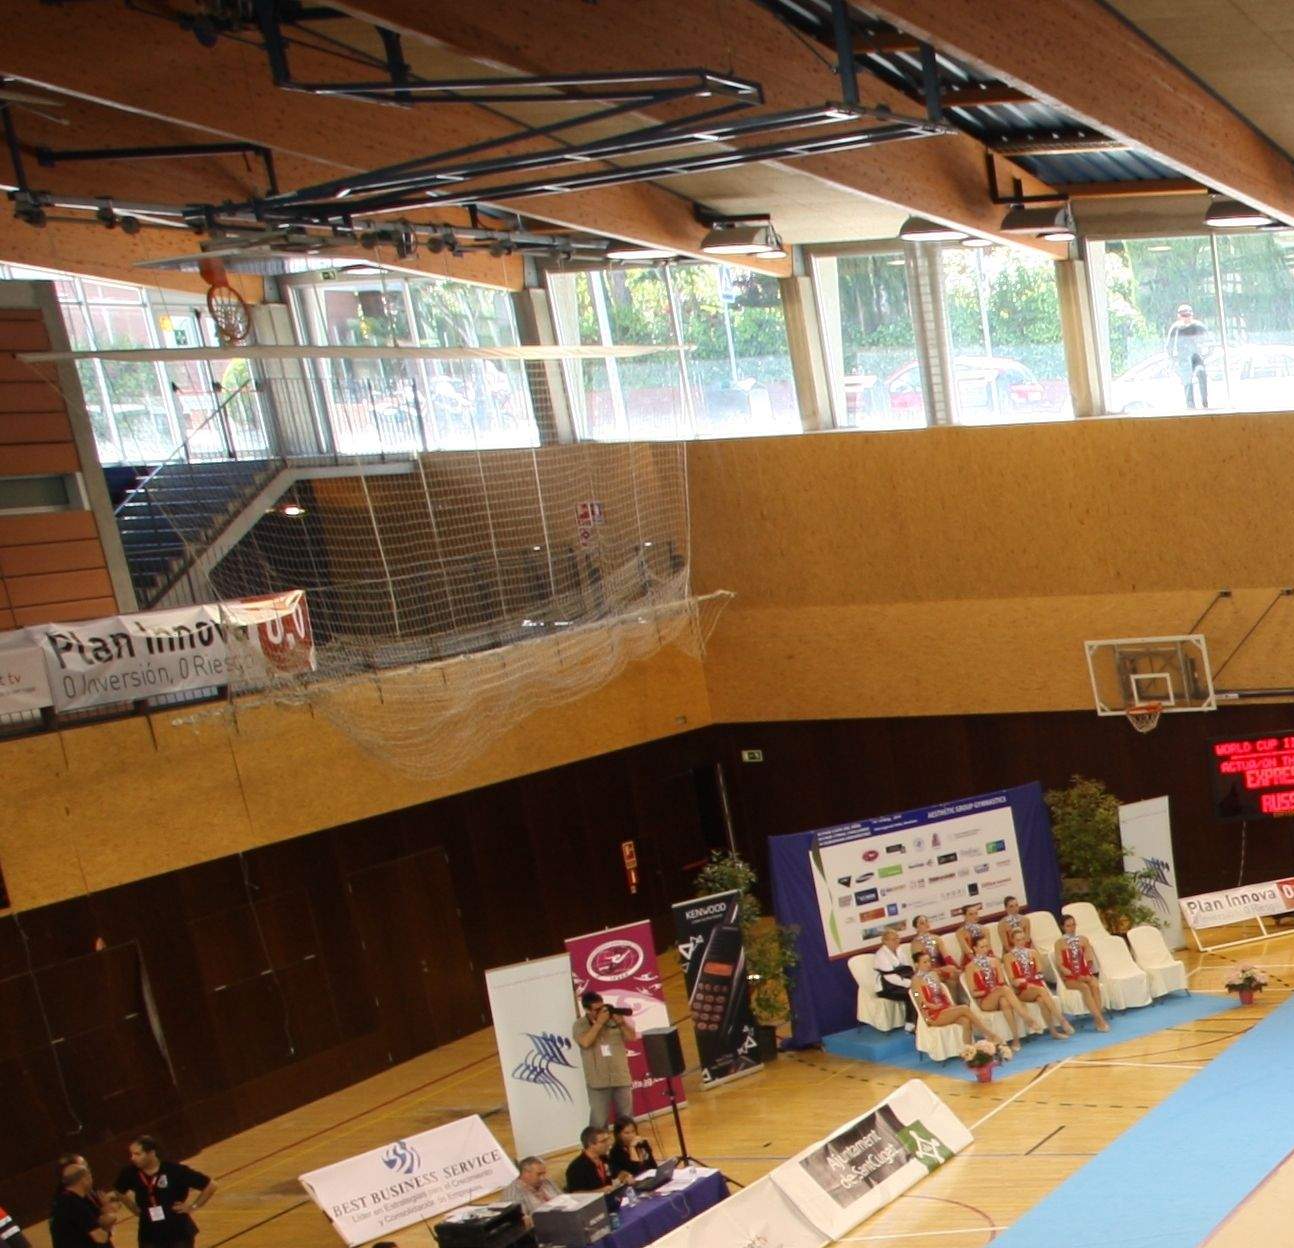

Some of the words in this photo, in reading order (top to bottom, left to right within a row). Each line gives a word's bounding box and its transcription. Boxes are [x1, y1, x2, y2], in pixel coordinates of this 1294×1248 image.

[46, 630, 135, 669] Plan
[63, 676, 76, 699] 0
[180, 658, 189, 680] 0
[1215, 742, 1252, 756] WORLD
[1256, 739, 1278, 751] CUP
[685, 903, 726, 920] KENWOOD
[1187, 897, 1223, 915] Plan
[1227, 888, 1276, 908] Innova
[826, 1129, 882, 1171] Ajuntament
[840, 1173, 858, 1189] de
[851, 1143, 899, 1180] SantCugat
[332, 1196, 368, 1218] BEST
[370, 1171, 439, 1204] BUSINESS
[442, 1149, 501, 1179] SERVICE
